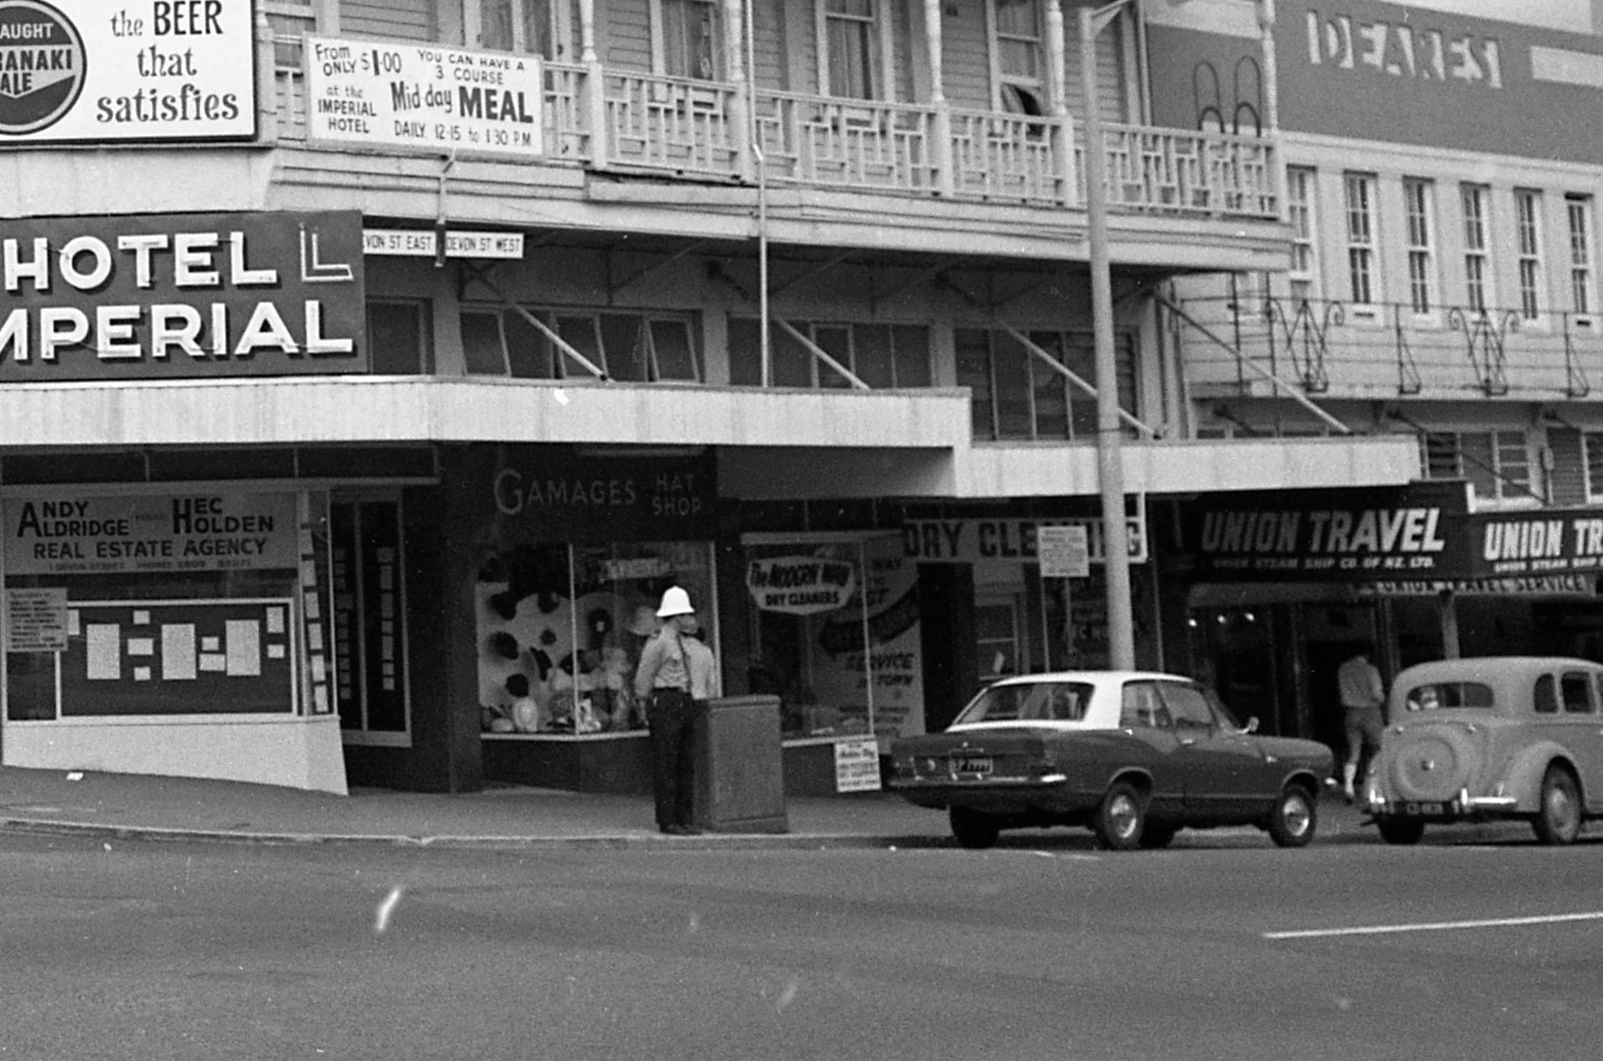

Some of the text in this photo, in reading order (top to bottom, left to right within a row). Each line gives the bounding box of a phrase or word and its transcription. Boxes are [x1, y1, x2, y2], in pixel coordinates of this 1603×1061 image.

[110, 0, 224, 38] the BEER
[136, 43, 198, 78] that
[314, 43, 351, 62] From
[417, 49, 525, 72] YOU CAN HAVE A
[322, 59, 357, 78] ONLY
[435, 65, 505, 86] 3 COURSE
[0, 72, 33, 94] ALE
[346, 85, 364, 100] the
[95, 83, 240, 123] satisfies
[317, 98, 378, 117] IMPERIAL
[458, 85, 535, 124] MEAL
[327, 117, 371, 135] HOTEL
[363, 234, 386, 250] VON
[406, 235, 433, 251] EAST
[3, 230, 277, 291] HOTEL
[493, 468, 637, 516] GAMAGES
[655, 473, 696, 492] HAT
[651, 495, 702, 517] SHOP
[902, 522, 964, 558] DRY
[1201, 507, 1446, 553] UNION TRAVEL
[1484, 520, 1564, 560] UNION
[33, 537, 267, 560] REAL ESTATE AGENCY
